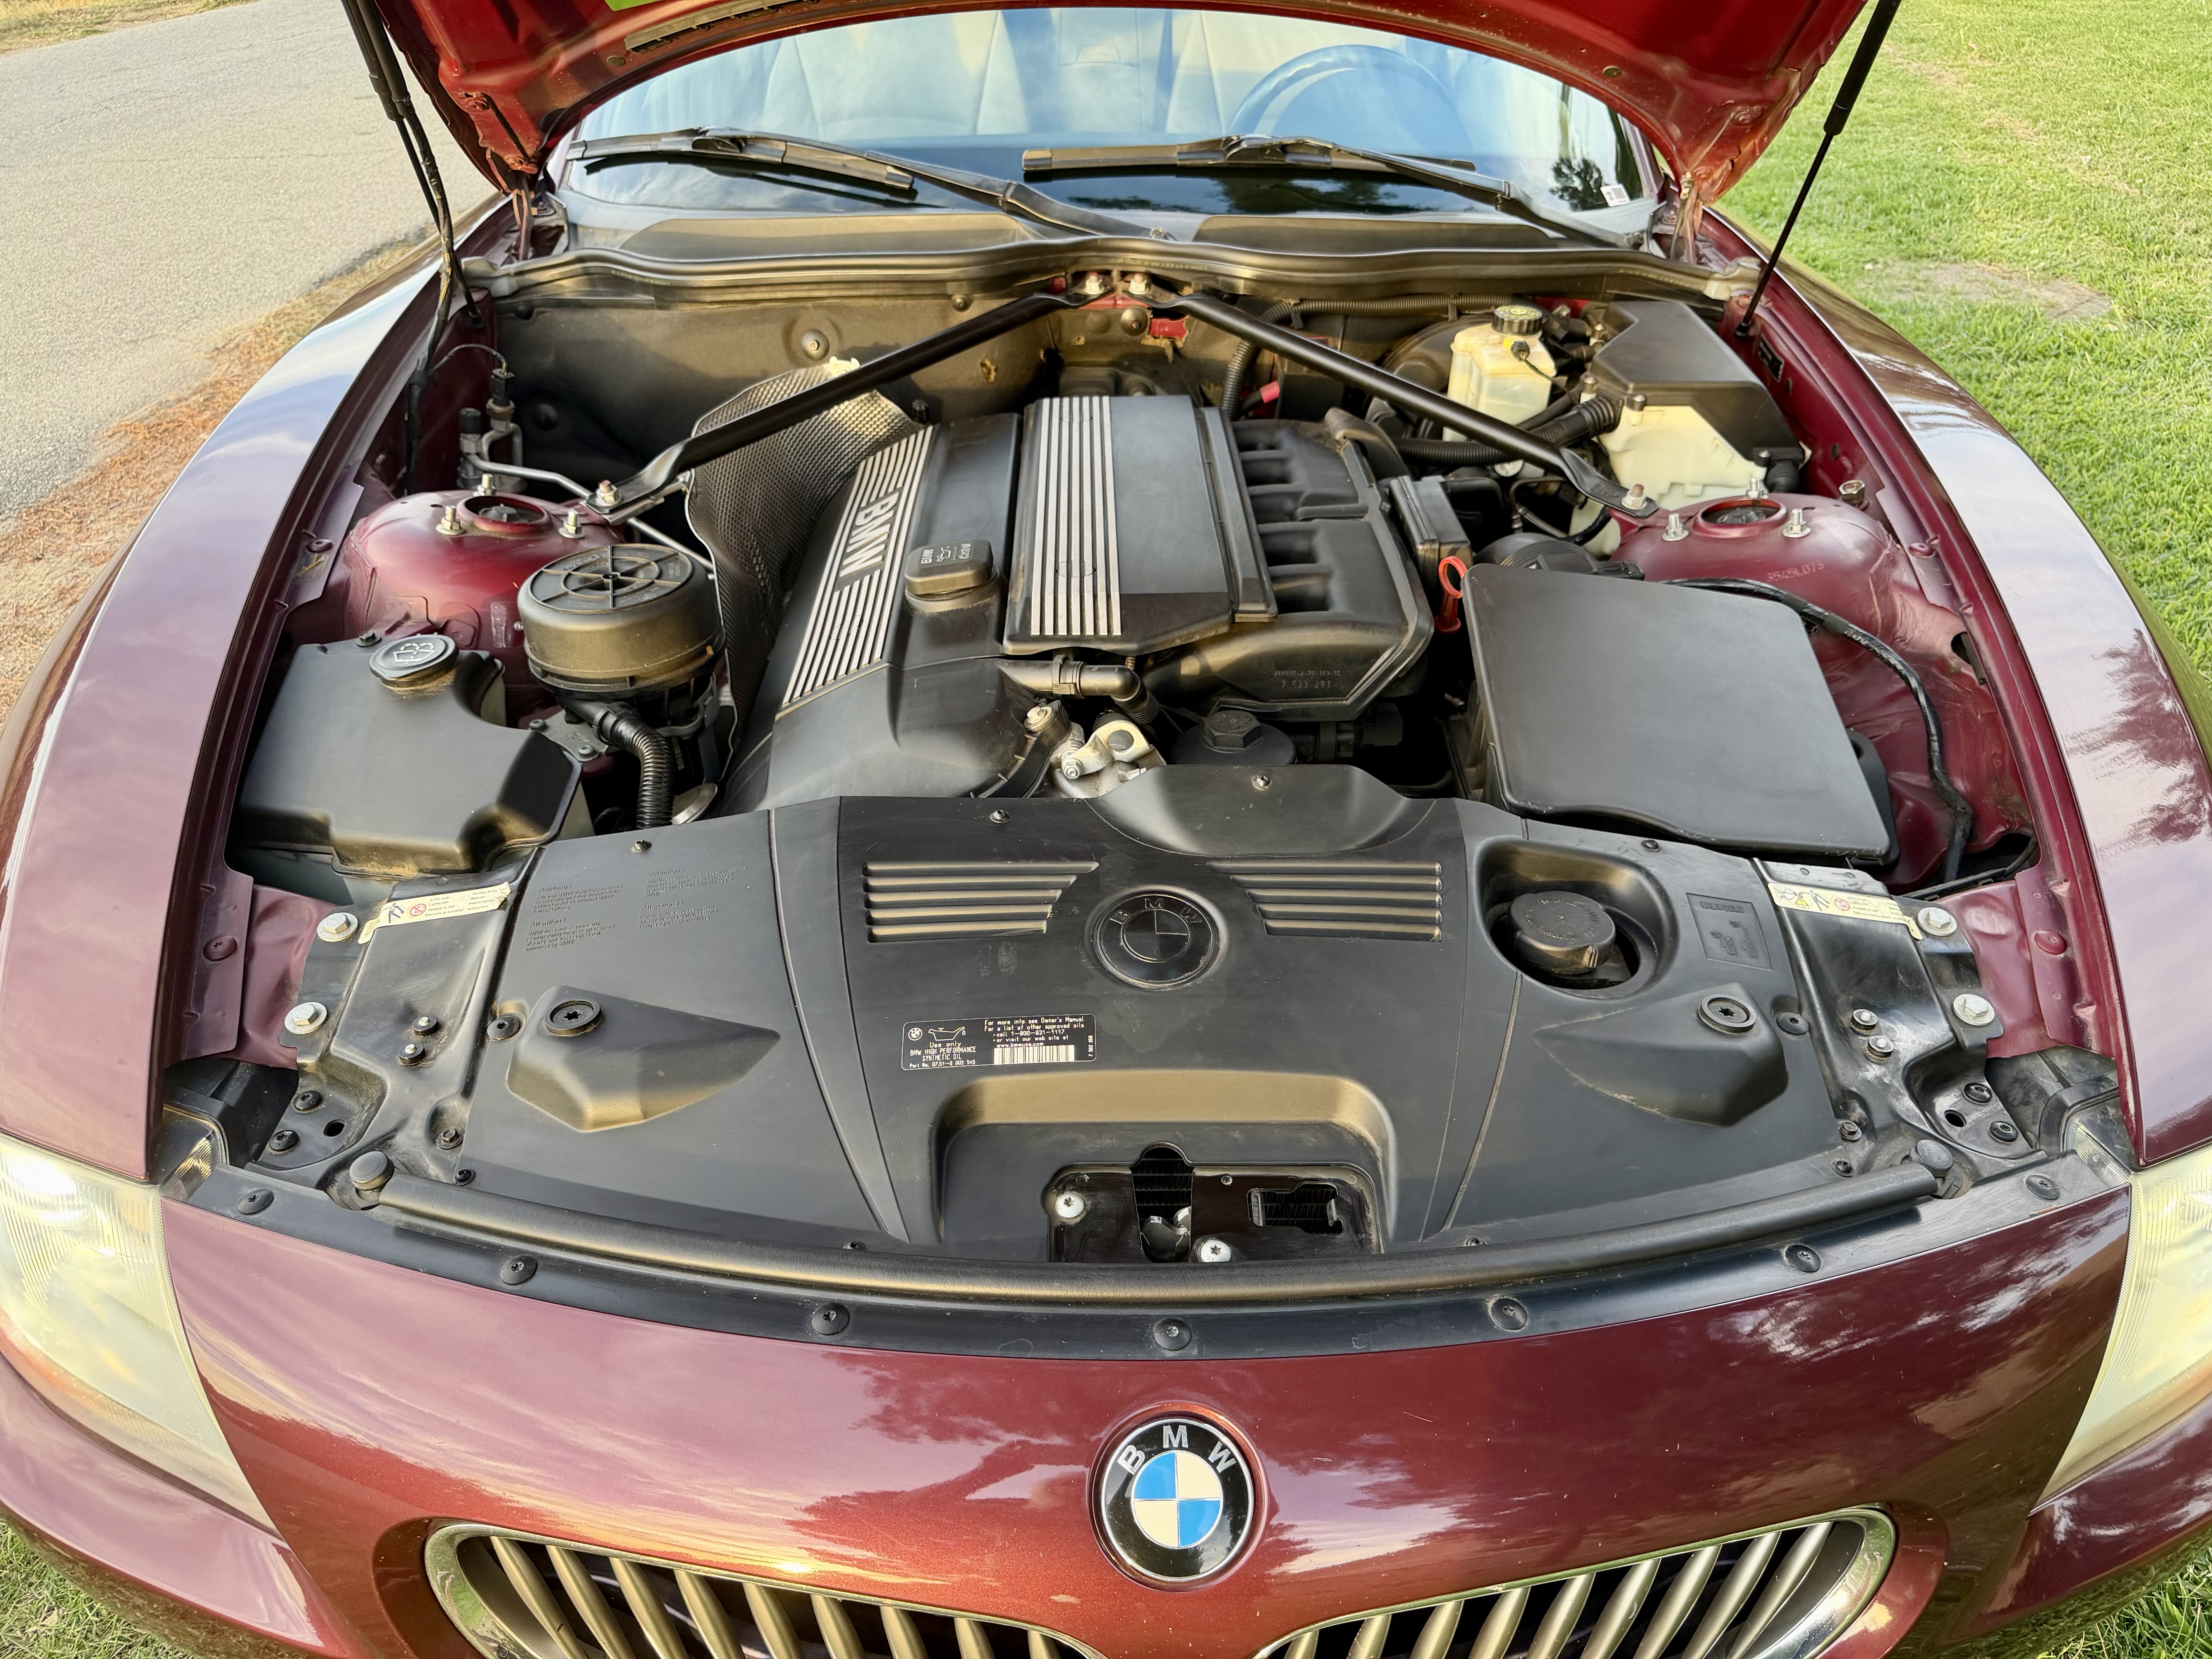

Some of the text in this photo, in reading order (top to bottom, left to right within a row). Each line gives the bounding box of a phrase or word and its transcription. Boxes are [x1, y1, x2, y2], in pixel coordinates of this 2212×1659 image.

[840, 492, 900, 577] BMW
[921, 549, 934, 564] BMW
[1314, 680, 1331, 688] 291
[1110, 898, 1202, 924] BMW
[946, 1041, 962, 1049] only
[1117, 1425, 1237, 1475] BMW
